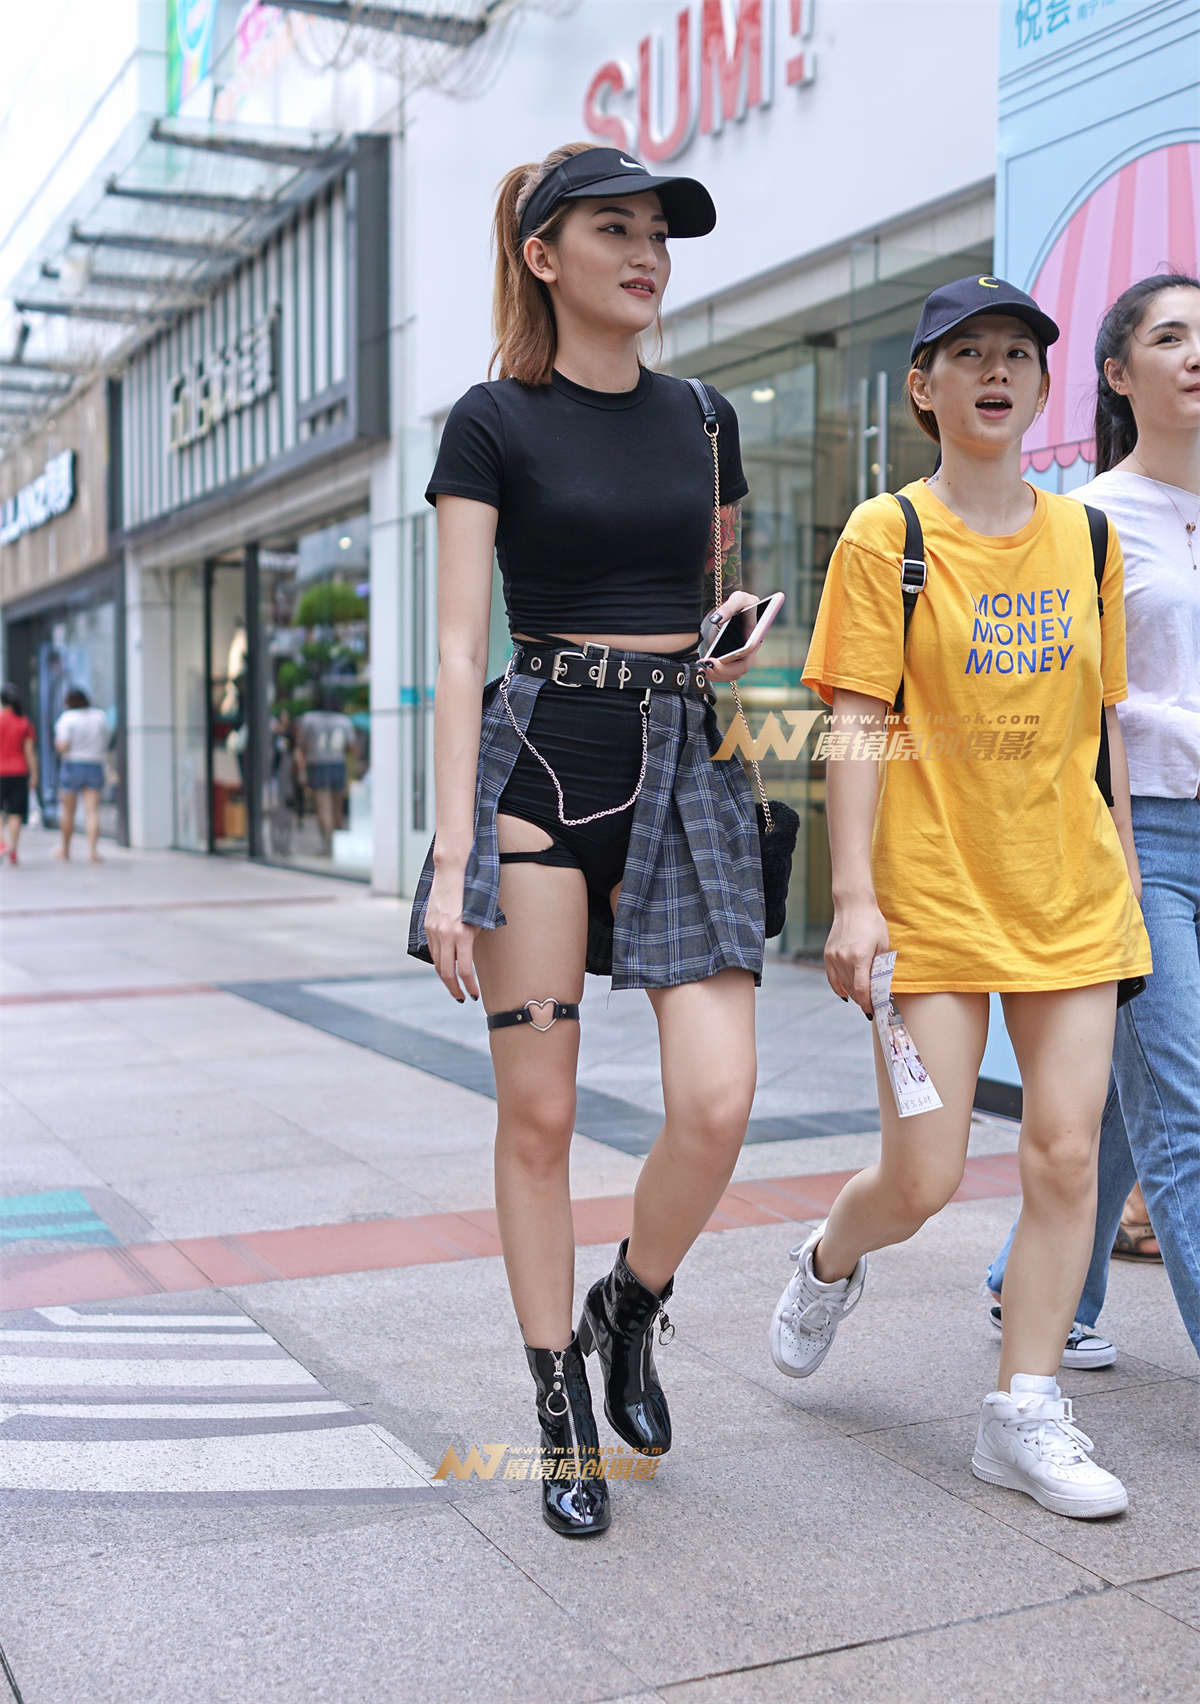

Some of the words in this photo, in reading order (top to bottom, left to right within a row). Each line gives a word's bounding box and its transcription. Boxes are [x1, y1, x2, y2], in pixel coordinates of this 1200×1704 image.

[970, 589, 1070, 618] MONEY
[972, 616, 1072, 645] MONEY
[965, 644, 1074, 674] MONEY
